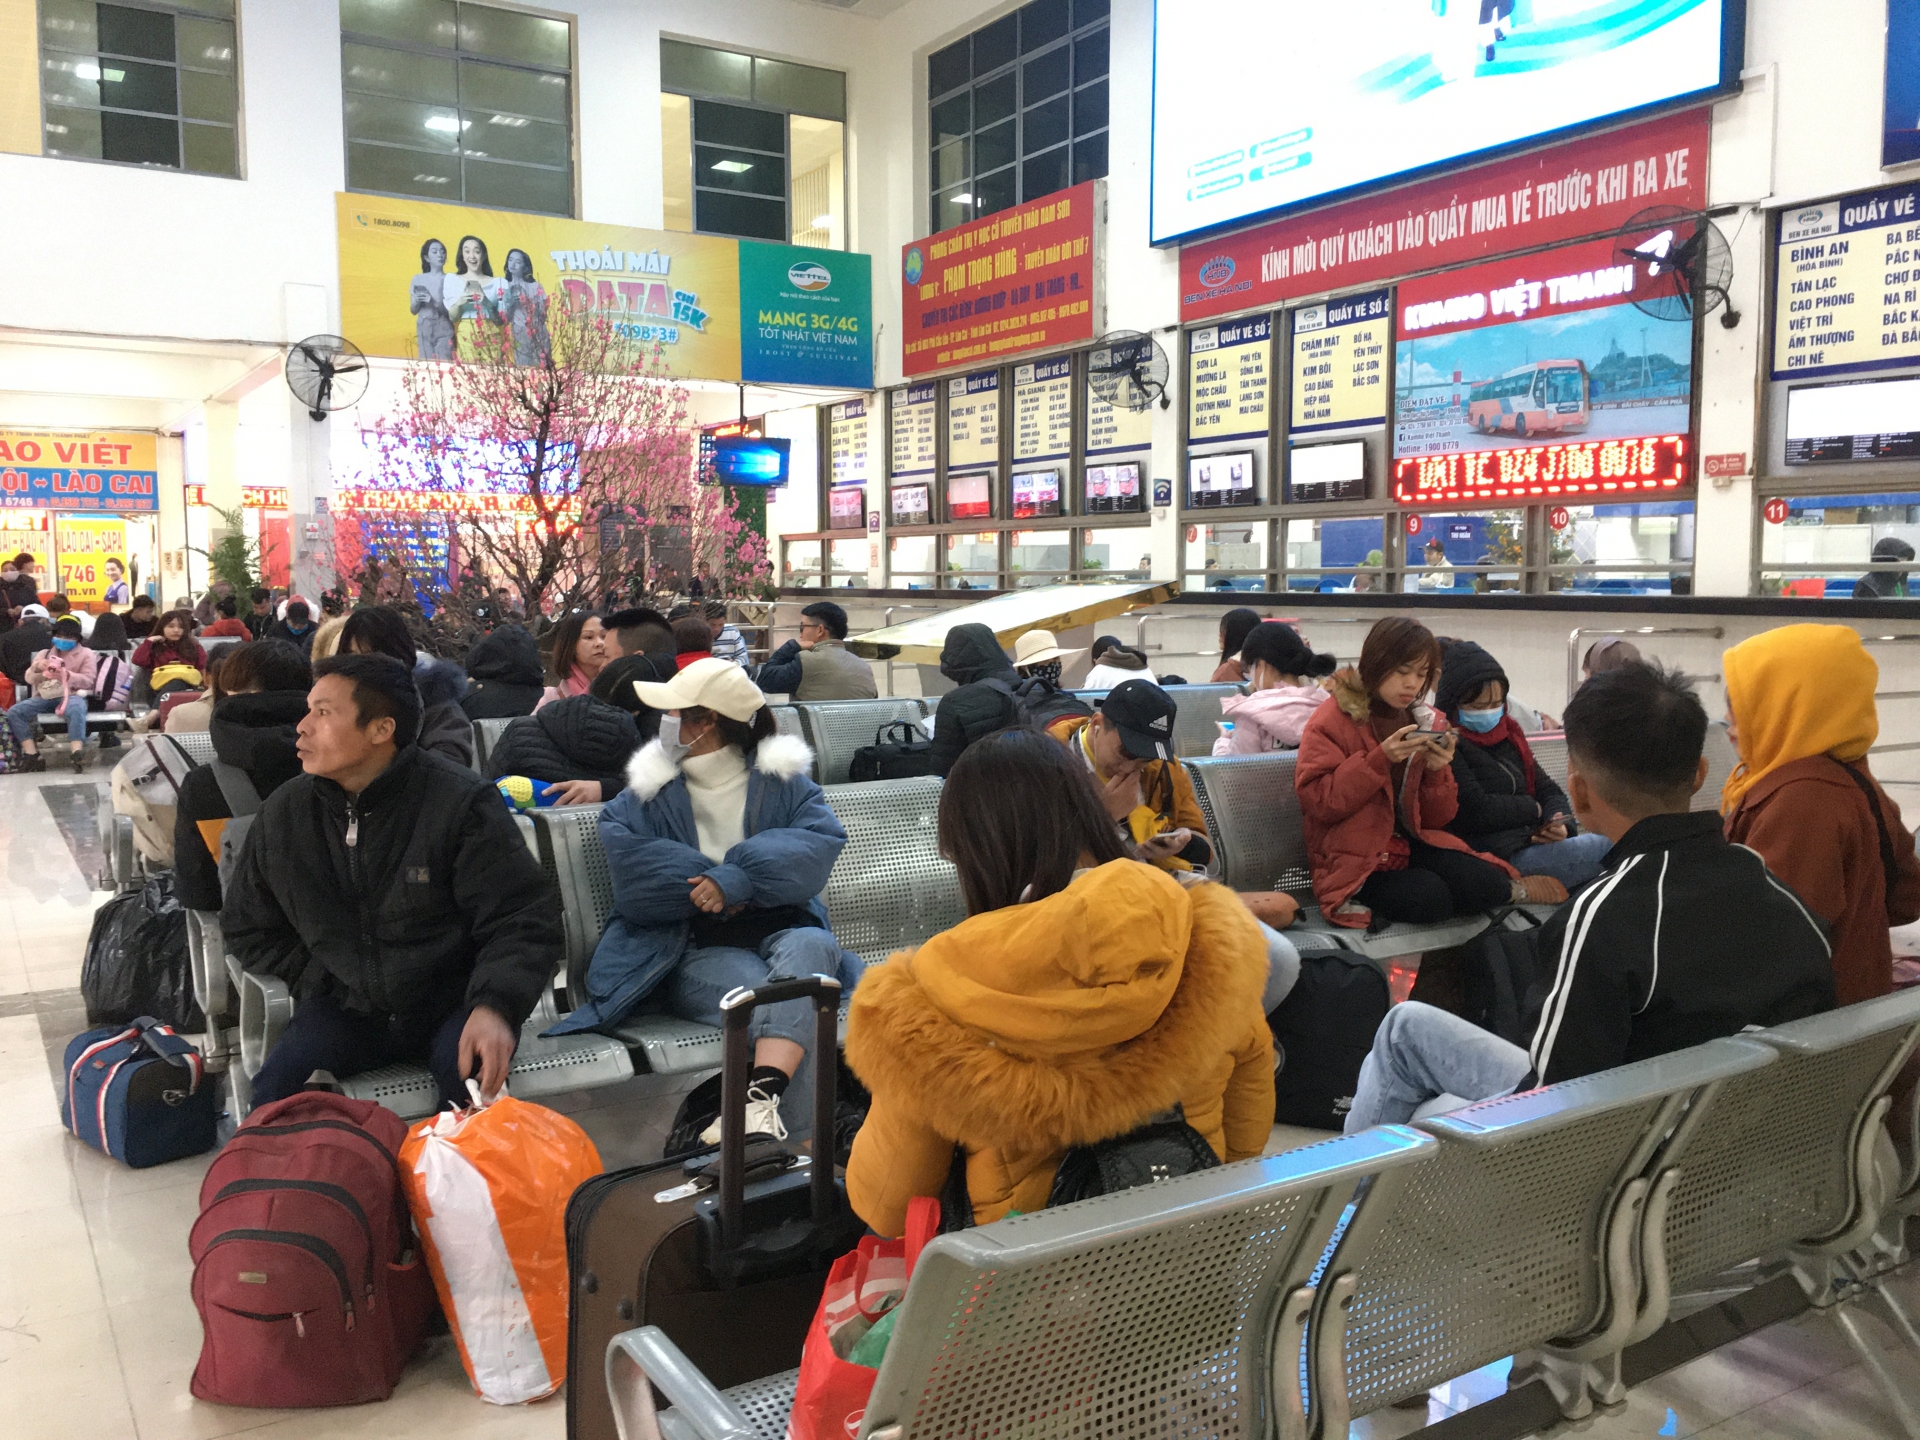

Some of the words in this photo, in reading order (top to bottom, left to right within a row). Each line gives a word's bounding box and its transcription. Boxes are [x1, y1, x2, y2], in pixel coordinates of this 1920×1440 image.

[1261, 246, 1290, 283] KÍNH
[1293, 235, 1317, 275] MỜI
[1320, 228, 1345, 272] QUÝ
[1348, 220, 1393, 262] KHÁCH
[1396, 211, 1424, 251] VÀO
[1428, 194, 1468, 247] QUẦY
[1471, 195, 1507, 234] MUA
[1512, 180, 1532, 224] VÉ
[1537, 168, 1592, 219] TRƯỚC
[1597, 164, 1628, 205] KHI
[1632, 156, 1658, 197] RA
[1663, 148, 1690, 190] XE
[1844, 197, 1889, 227] QUẦY
[1894, 193, 1915, 216] VÉ
[373, 217, 410, 228] 1800.8098
[1886, 231, 1902, 245] BA
[1791, 244, 1824, 262] BÌNH
[1829, 240, 1849, 256] AN
[550, 244, 623, 271] THOẢI
[627, 248, 670, 275] MÁI
[943, 259, 965, 297] PHẠM
[967, 255, 992, 290] TRỌNG
[995, 246, 1017, 279] HÙNG
[1885, 269, 1910, 287] CHỢ
[1490, 278, 1542, 317] VIỆT
[1546, 264, 1634, 305] THANH
[1791, 279, 1812, 294] TÂN
[1816, 276, 1837, 292] LẠC
[560, 277, 669, 317] DATA
[1790, 298, 1812, 312] CAO
[1815, 292, 1855, 309] PHONG
[1884, 292, 1900, 306] NA
[1355, 301, 1367, 318] VÉ
[1369, 296, 1382, 315] SỐ
[672, 301, 708, 330] 15K
[758, 309, 807, 328] MẠNG
[810, 313, 858, 332] 3G/4G
[1789, 316, 1812, 332] VIỆT
[1816, 312, 1833, 327] TRÌ
[1883, 308, 1907, 326] BẮC
[759, 326, 780, 339] TỐT
[782, 328, 810, 341] NHẤT
[812, 331, 832, 344] VIỆT
[834, 335, 858, 346] NAM
[1243, 323, 1252, 340] VÉ
[1254, 319, 1266, 337] SỐ
[1363, 332, 1372, 342] HẠ
[1809, 330, 1855, 347] THƯỢNG
[759, 349, 790, 357] FROST
[810, 352, 858, 362] SULLIVAN
[1353, 347, 1365, 358] YÊN
[1052, 362, 1060, 376] VÉ
[1061, 359, 1069, 374] SỐ
[1196, 359, 1208, 370] SƠN
[1353, 363, 1364, 375] LẠC
[1366, 360, 1379, 370] SƠN
[1788, 354, 1806, 368] CHI
[1303, 365, 1317, 377] KIM
[1251, 377, 1267, 387] THANH
[1304, 382, 1316, 392] CAO
[1366, 374, 1380, 385] SƠN
[1017, 387, 1025, 397] HÀ
[1027, 385, 1046, 395] GIANG
[1196, 386, 1209, 399] MỘC
[1211, 384, 1227, 396] CHÂU
[1239, 393, 1253, 404] LẠNG
[1254, 391, 1264, 401] SƠN
[1217, 398, 1231, 409] NHAI
[1239, 406, 1249, 415] MAI
[1209, 413, 1220, 424] YÊN
[1317, 408, 1331, 418] NAM
[53, 437, 132, 467] VIỆT
[1398, 444, 1422, 454] Hotline:
[1425, 442, 1440, 451] 1900
[1442, 441, 1459, 450] 6779
[0, 468, 28, 495] ỘI
[52, 469, 102, 493] LÀO
[109, 474, 153, 494] CAI
[5, 497, 33, 507] 6746
[1553, 512, 1567, 524] 10
[1767, 504, 1784, 519] 11
[1410, 518, 1418, 532] 9
[101, 530, 123, 553] SAPA
[1189, 528, 1195, 540] 7
